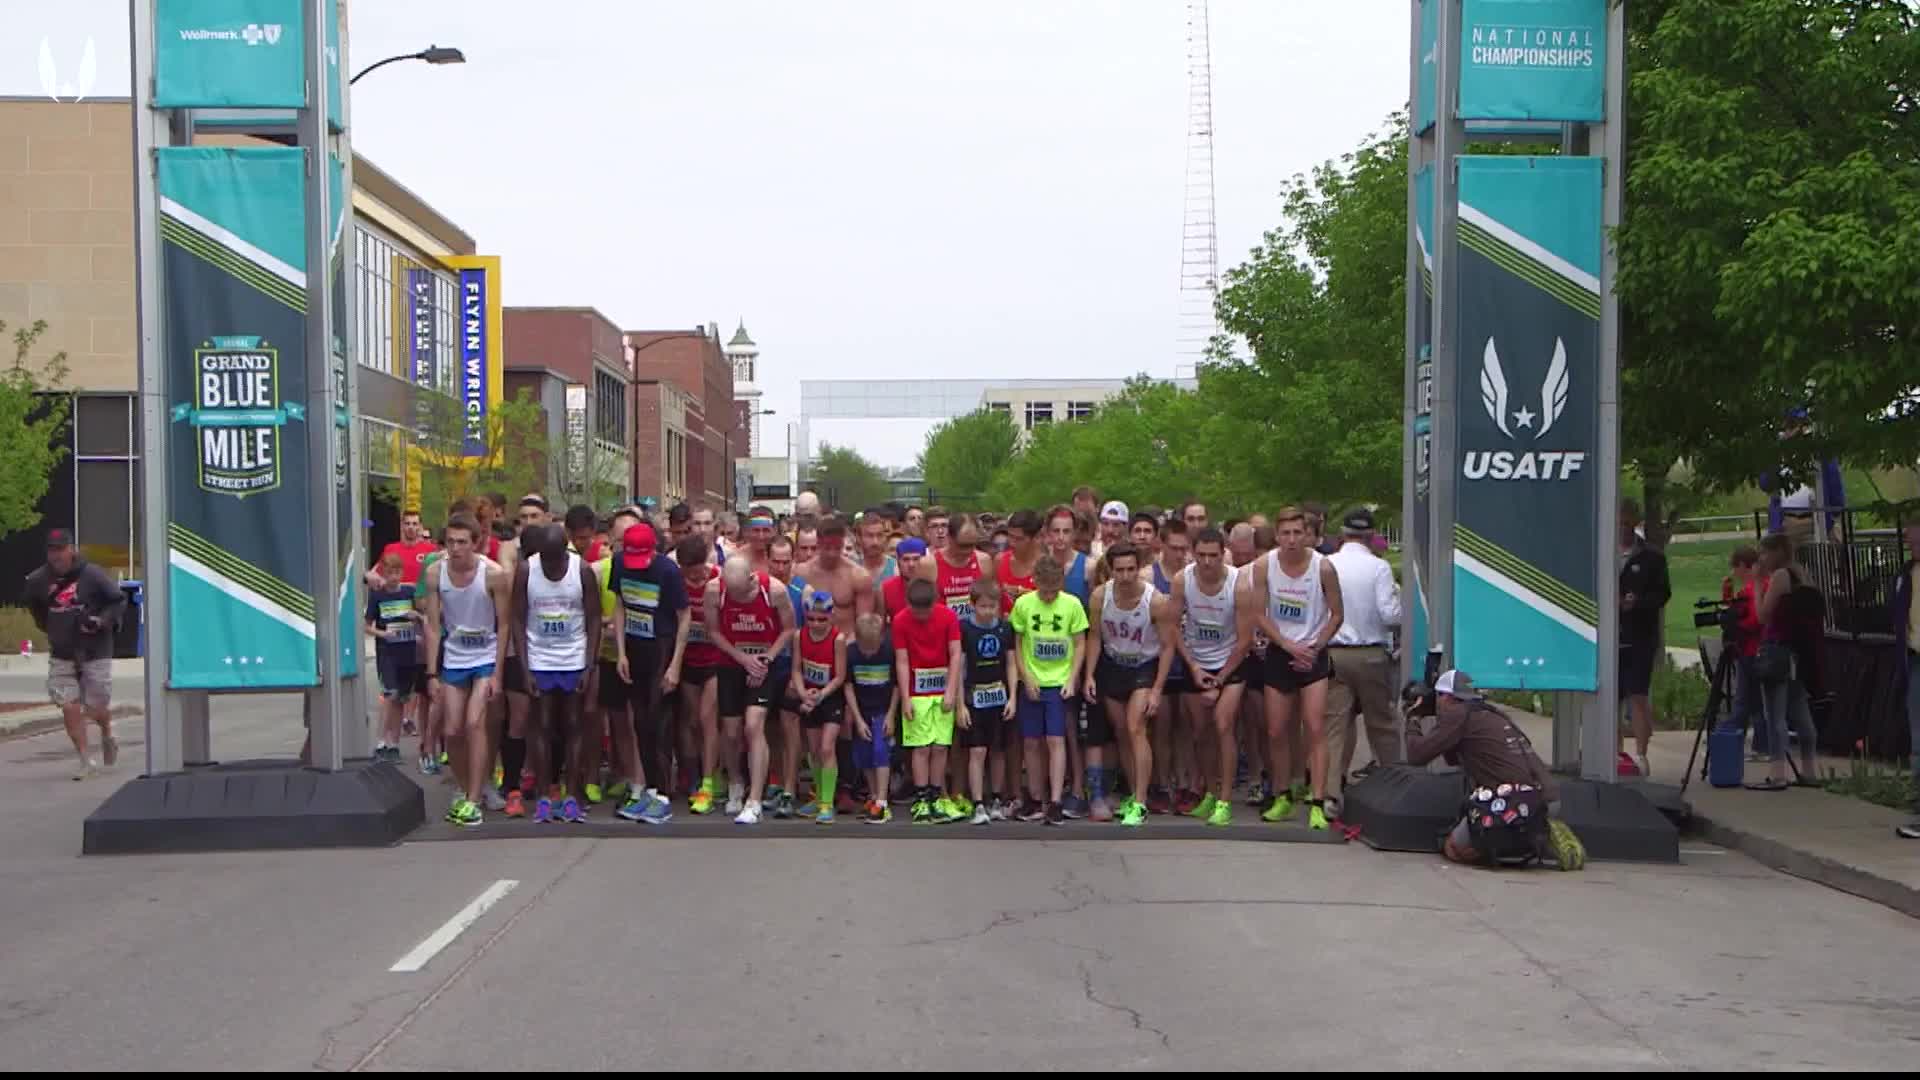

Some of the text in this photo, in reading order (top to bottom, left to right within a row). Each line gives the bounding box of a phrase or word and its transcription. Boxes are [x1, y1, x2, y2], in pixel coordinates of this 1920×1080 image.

[179, 30, 238, 41] Wellmark
[1472, 28, 1592, 46] NATIONAL
[1472, 46, 1592, 66] CHAMPIONSHIPS
[466, 282, 480, 350] FLYNN
[202, 354, 270, 370] GRAND
[203, 372, 271, 407] BLUE
[203, 428, 273, 469] MILE
[1463, 451, 1585, 480] USATF
[204, 474, 249, 489] STREET
[1103, 619, 1143, 644] USA
